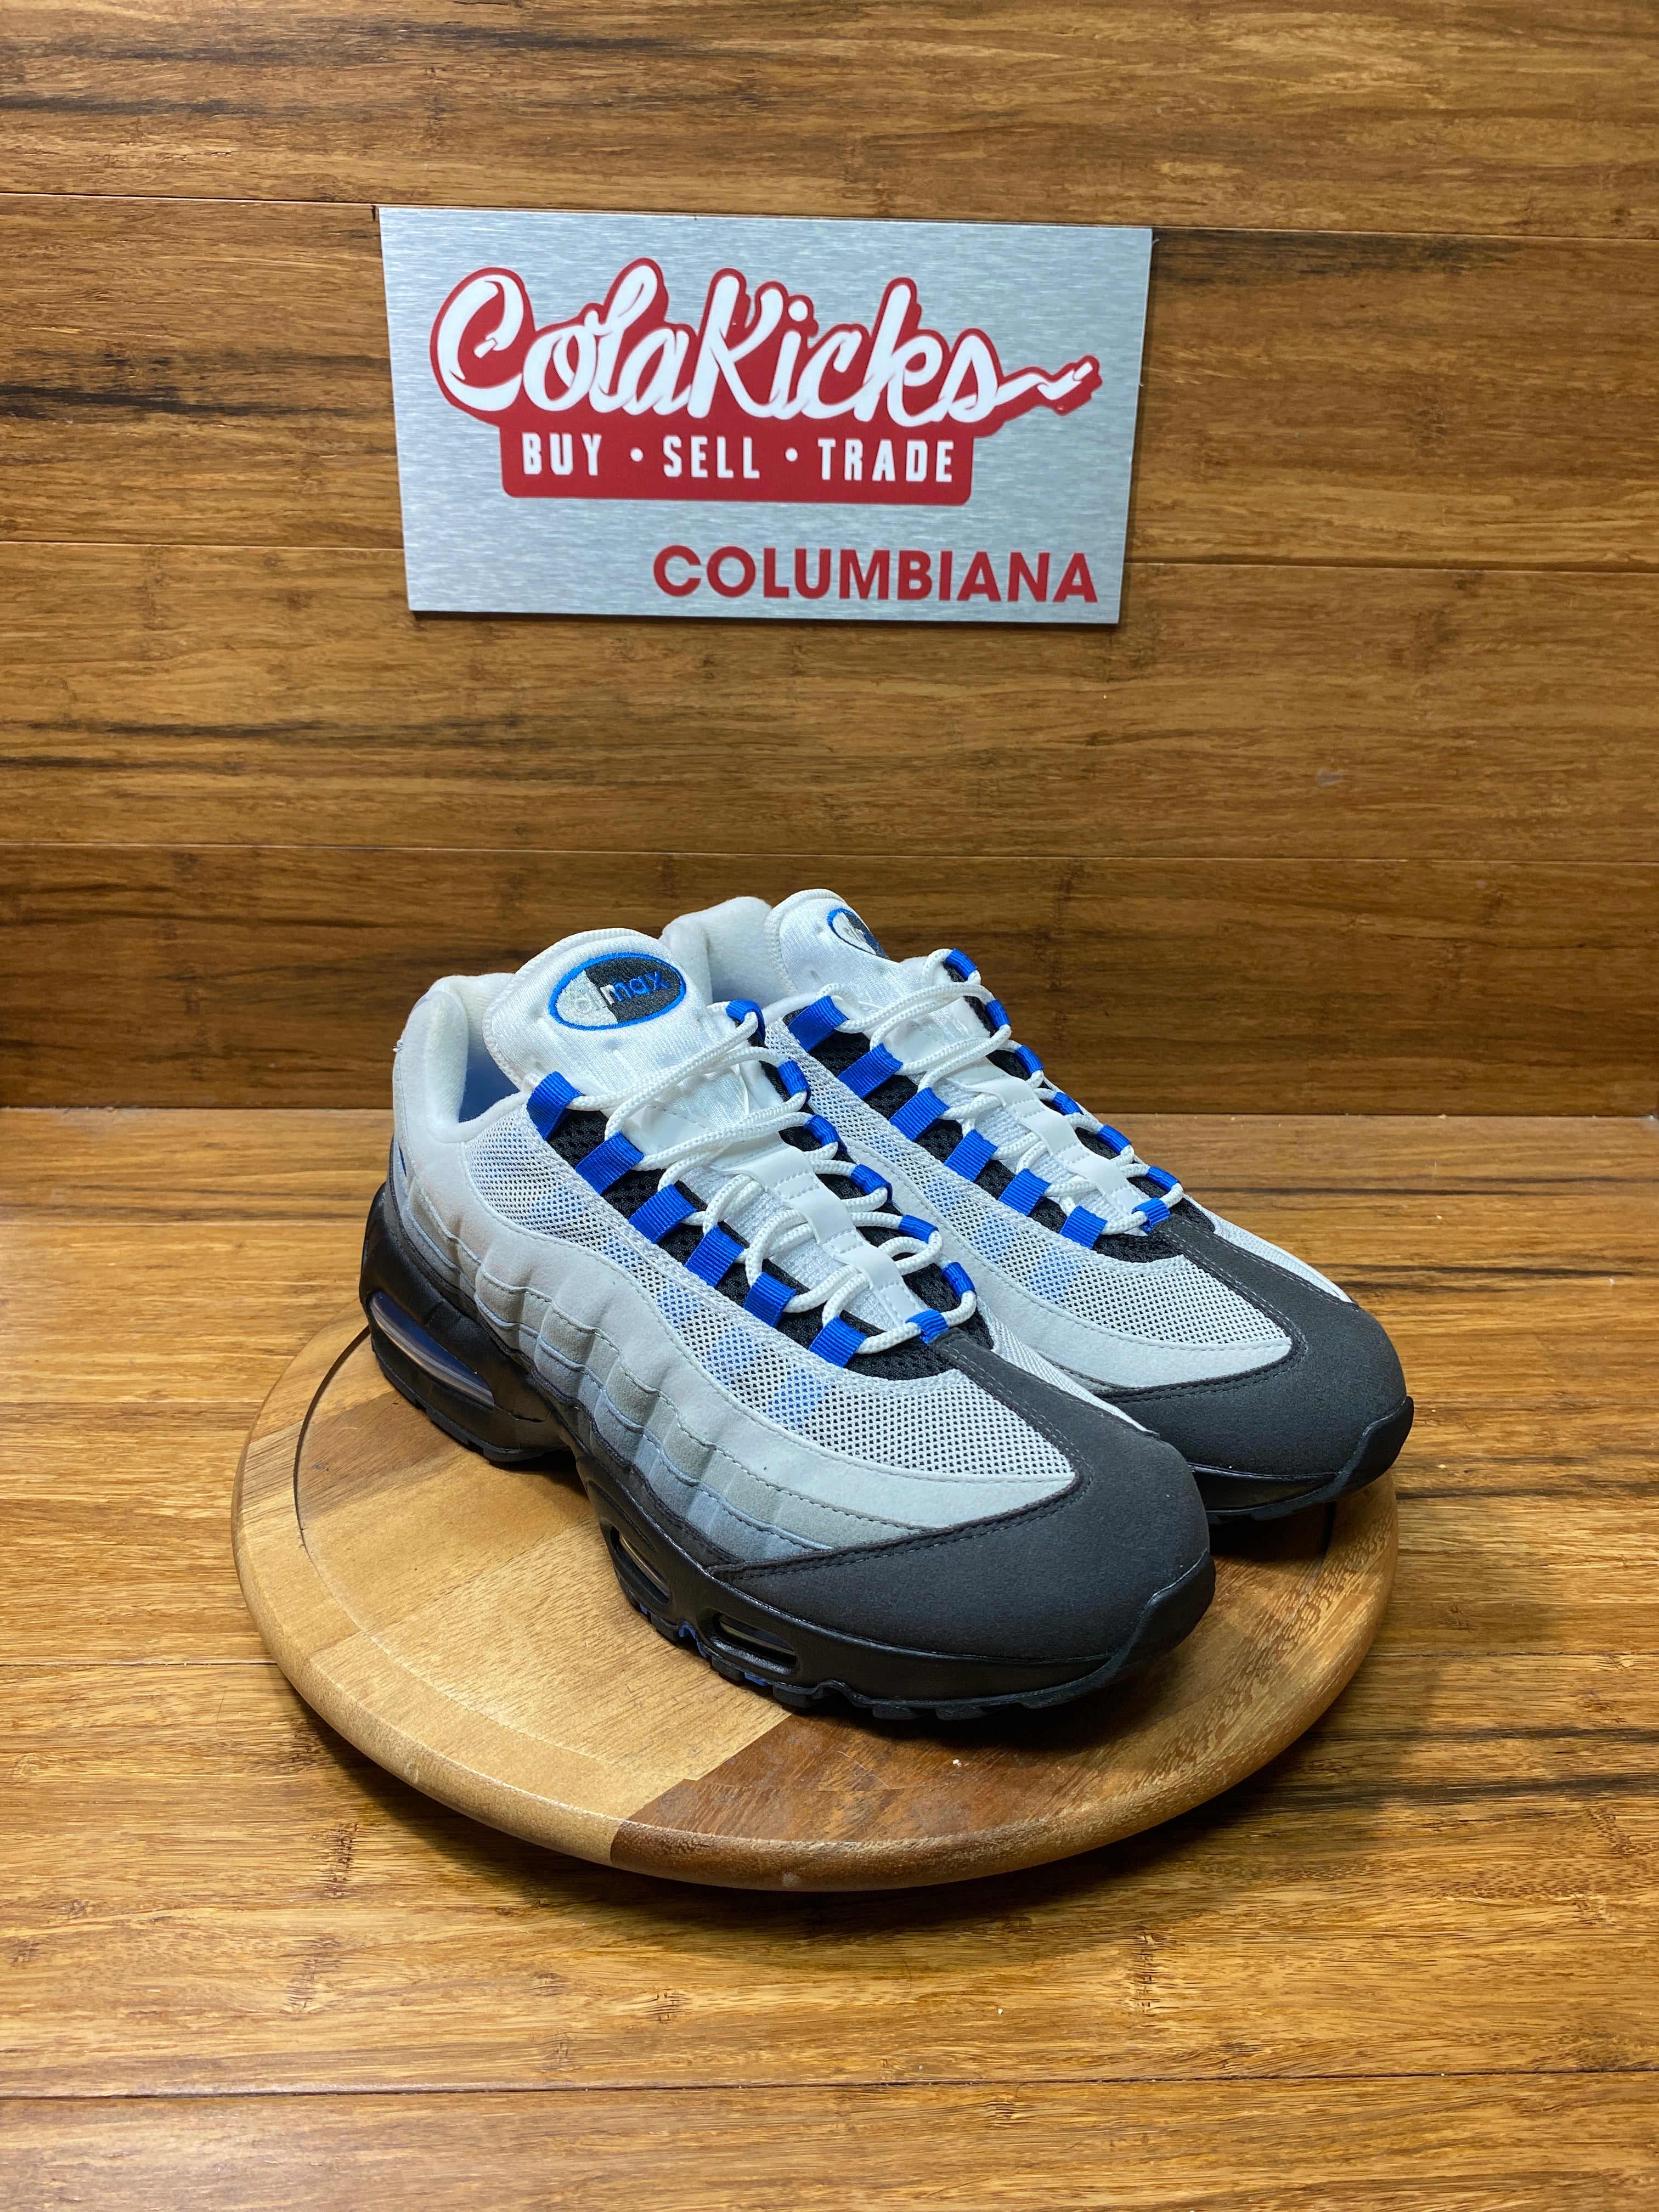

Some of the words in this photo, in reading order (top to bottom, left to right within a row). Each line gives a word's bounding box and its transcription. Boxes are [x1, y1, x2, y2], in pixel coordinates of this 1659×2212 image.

[437, 264, 1094, 426] ColaKicks
[522, 432, 602, 476] BUY
[663, 435, 760, 479] SELL
[818, 438, 954, 483] TRADE
[653, 545, 1097, 603] COLUMBIANA
